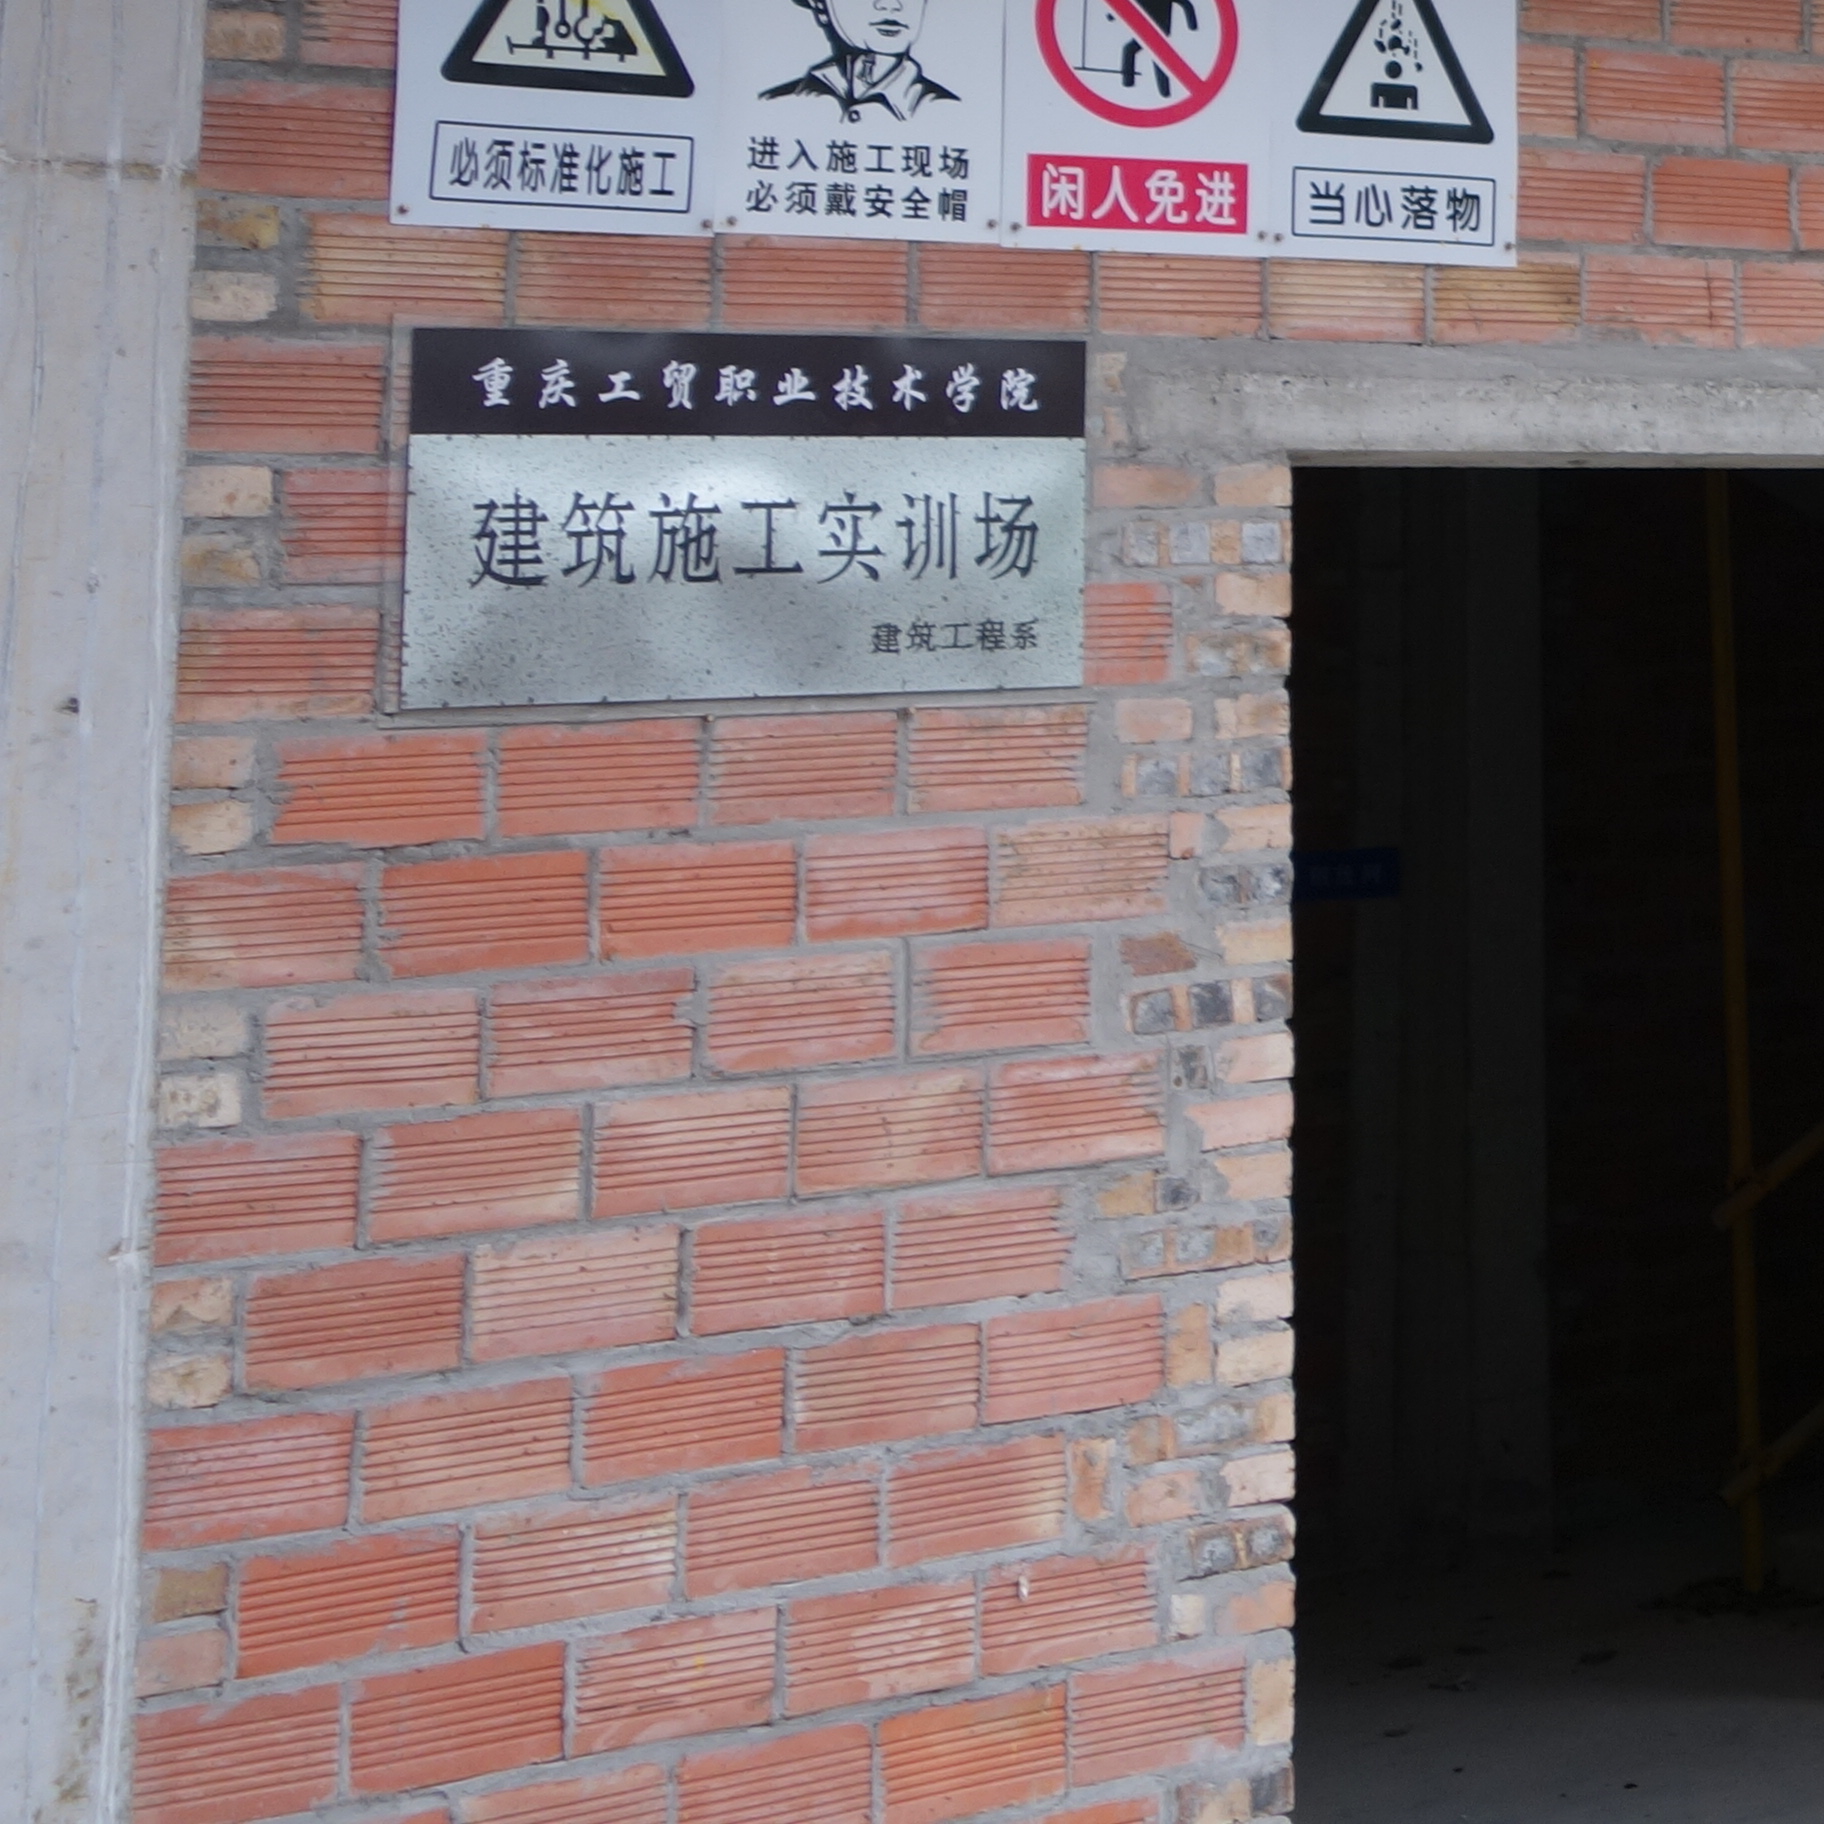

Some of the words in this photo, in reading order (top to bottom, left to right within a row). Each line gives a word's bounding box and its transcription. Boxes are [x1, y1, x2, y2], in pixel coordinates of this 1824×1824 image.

[449, 136, 678, 198] 必须标准化施工
[746, 136, 970, 181] 进入施工现场
[746, 180, 968, 223] 必须戴安全帽
[1039, 162, 1238, 226] 闲人免进
[1307, 180, 1482, 233] 当心落物
[472, 356, 1041, 412] 重庆工贸职业技术学院
[470, 490, 1039, 587] 建筑施工实训场
[869, 617, 1040, 654] 建筑工程系
